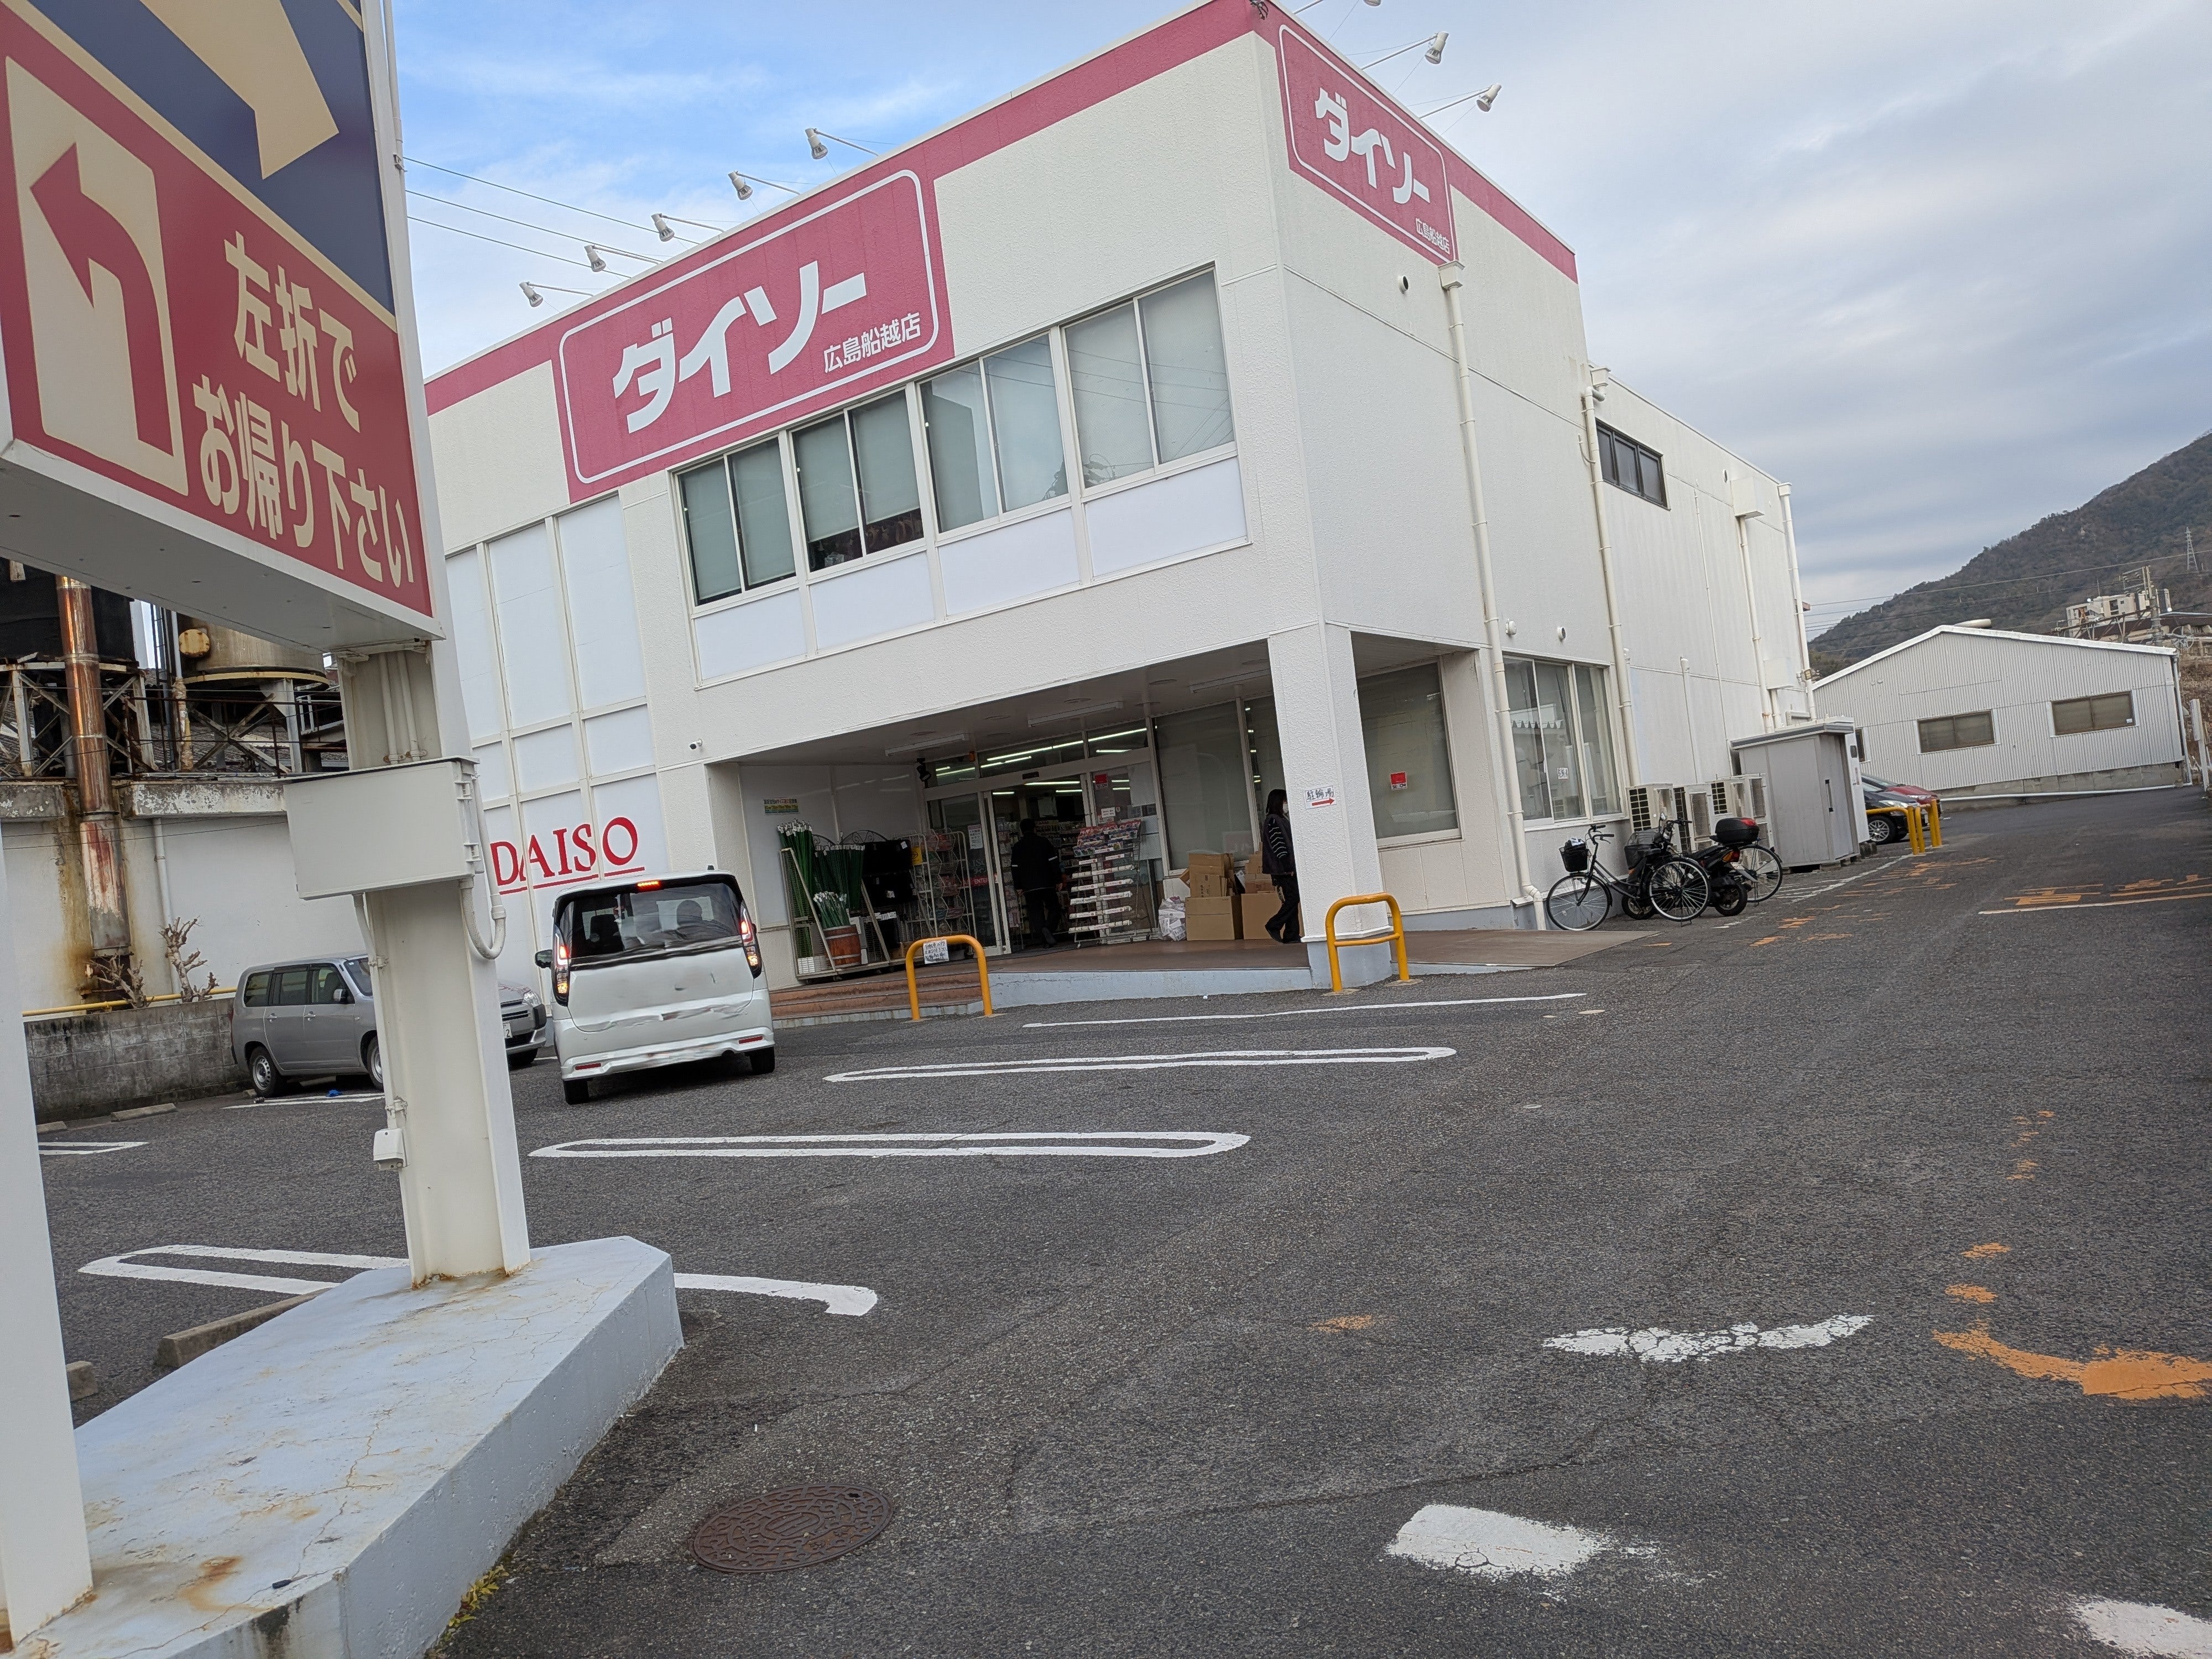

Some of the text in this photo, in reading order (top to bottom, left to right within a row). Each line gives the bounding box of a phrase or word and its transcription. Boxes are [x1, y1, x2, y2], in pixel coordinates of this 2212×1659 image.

[1315, 87, 1430, 204] ダイソー
[224, 230, 361, 434] 左折で
[612, 260, 867, 434] ダイソー
[823, 312, 921, 373] 広島船越店
[192, 374, 414, 588] お帰り下さい
[489, 817, 638, 886] DAISO
